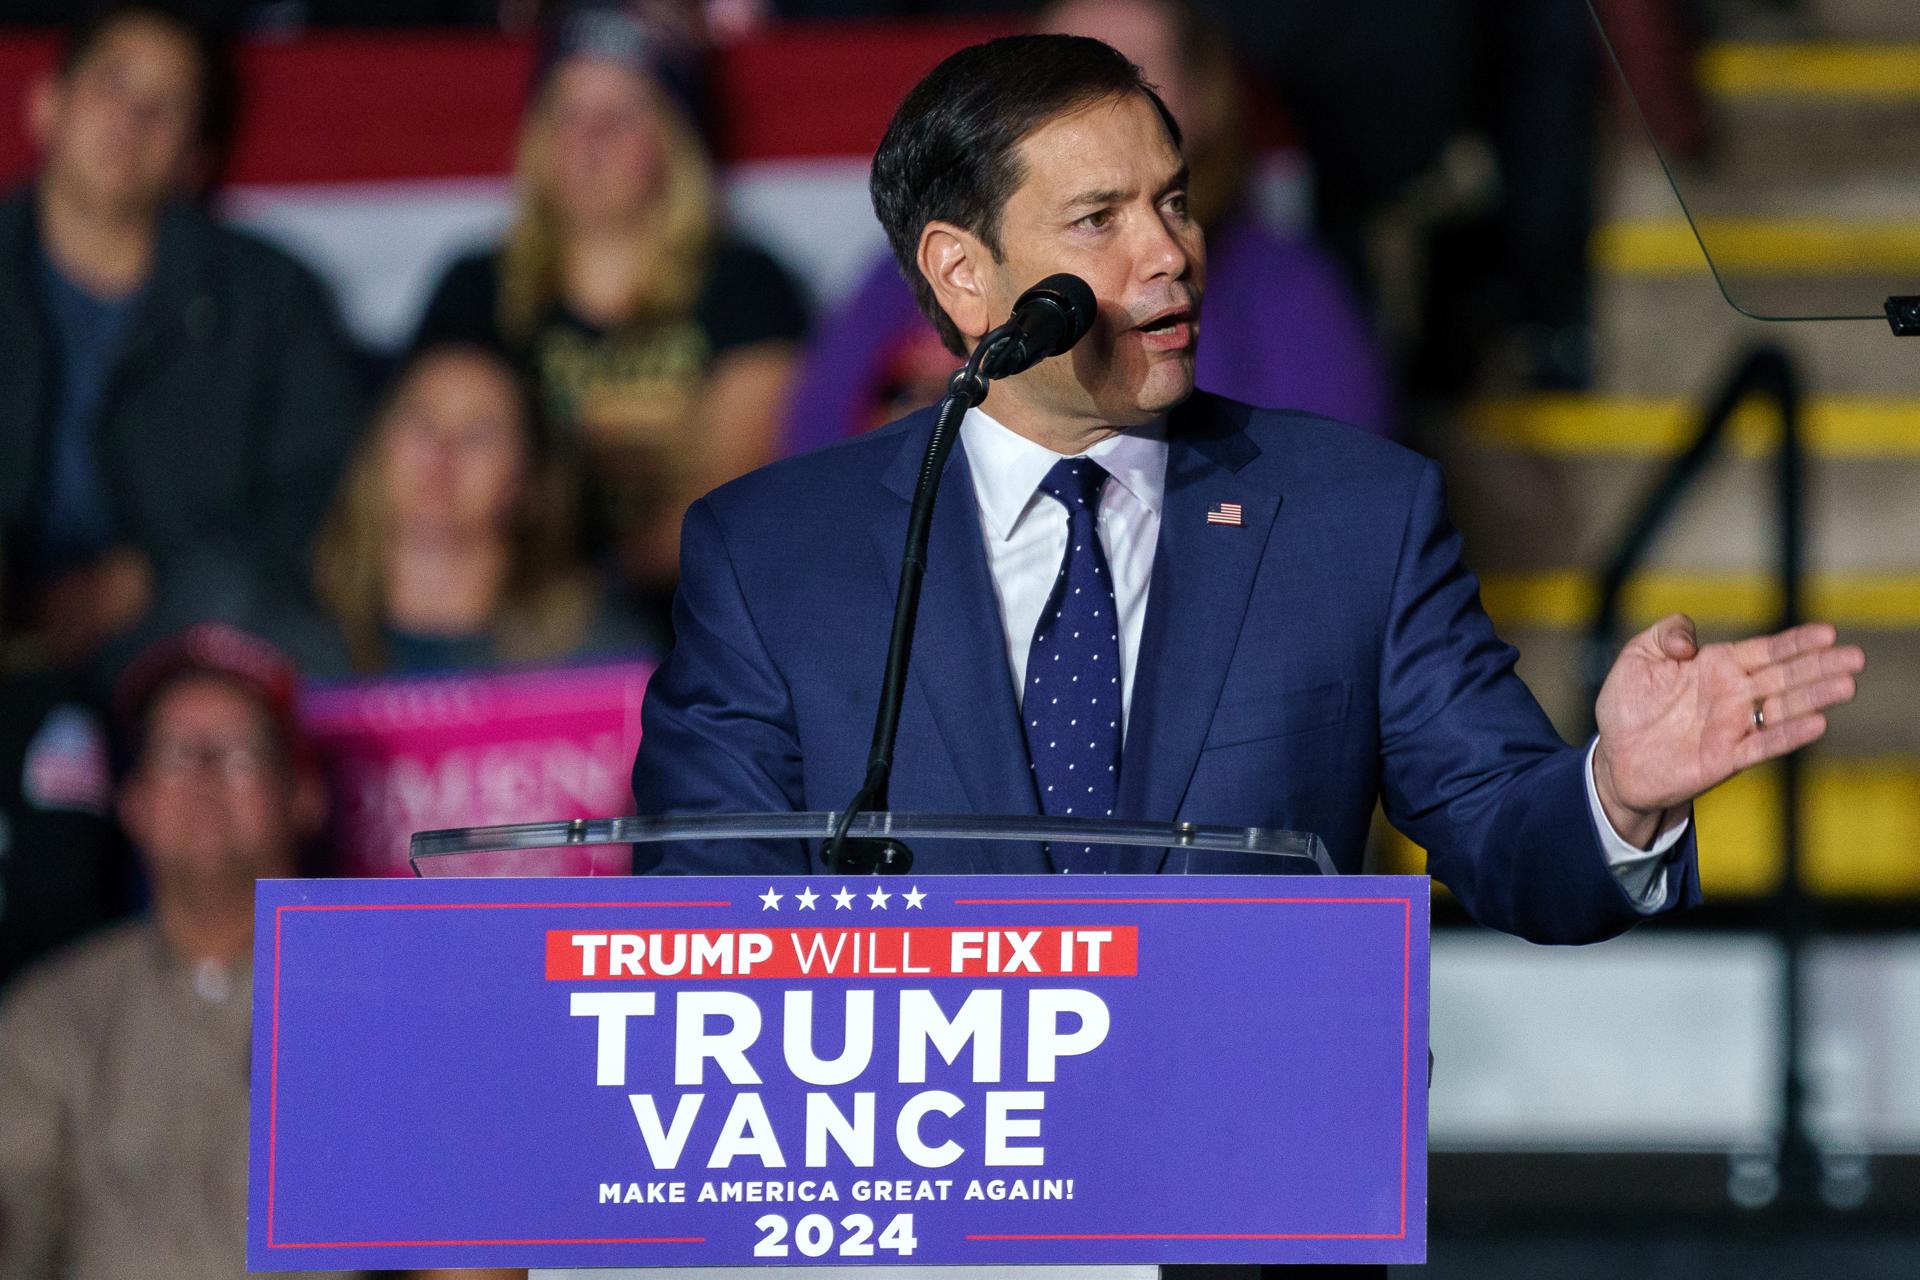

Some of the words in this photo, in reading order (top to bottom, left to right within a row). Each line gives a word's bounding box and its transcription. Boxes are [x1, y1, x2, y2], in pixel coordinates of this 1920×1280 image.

[572, 933, 774, 976] TRUMP
[790, 931, 931, 975] WILL
[950, 930, 1043, 973] FIX
[1060, 930, 1113, 973] IT
[569, 988, 1111, 1086] TRUMP
[627, 1090, 1045, 1170] VANCE
[598, 1182, 686, 1204] MAKE
[696, 1180, 840, 1203] AMERICA
[851, 1179, 953, 1202] GREAT
[963, 1179, 1074, 1201] AGAIN!
[753, 1213, 918, 1258] 2024
